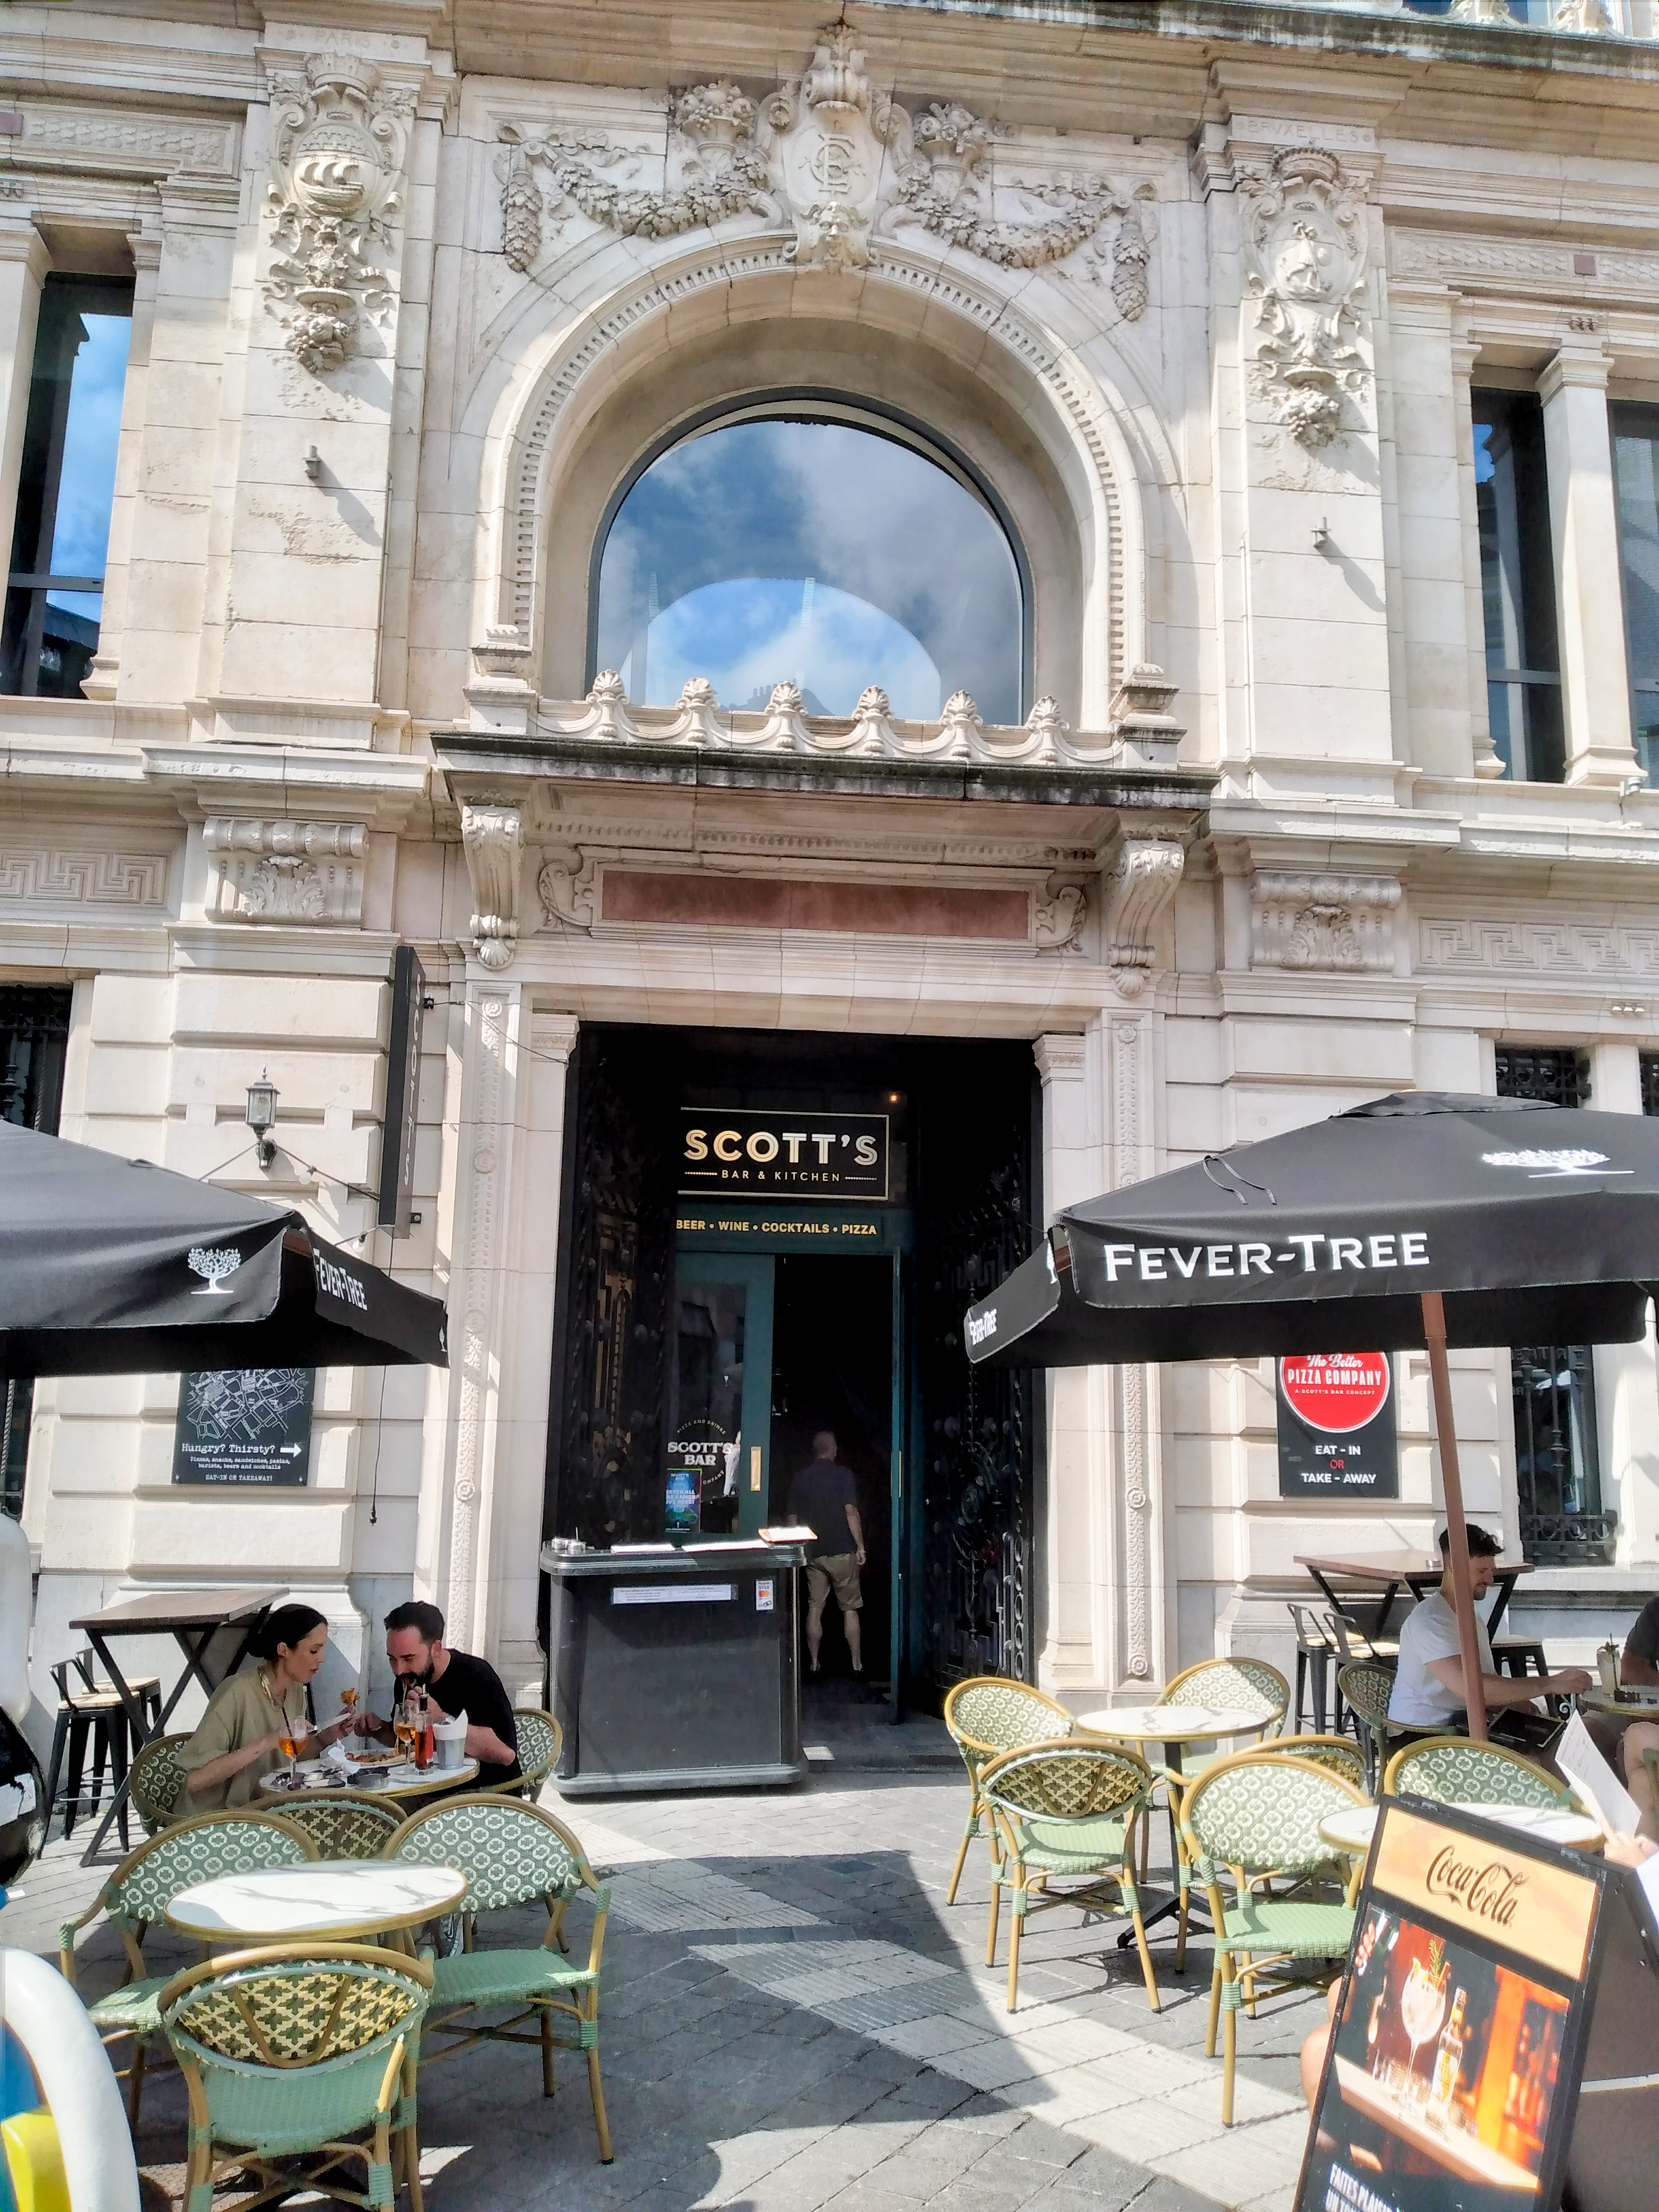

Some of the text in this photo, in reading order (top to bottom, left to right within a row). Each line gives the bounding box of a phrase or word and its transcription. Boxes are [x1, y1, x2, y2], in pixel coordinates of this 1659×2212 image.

[683, 1129, 878, 1166] SCOTT'S
[722, 1170, 840, 1182] BAR & KITCHEN
[676, 1220, 877, 1235] BEER WINE COCKTAILS PIZZA
[1103, 1233, 1430, 1281] FEVER-TREE
[1306, 1353, 1364, 1368] The Better
[1287, 1369, 1382, 1386] PIZZA COMPANY
[676, 1422, 692, 1434] PIZZA
[707, 1420, 726, 1435] DRINKS
[181, 1443, 275, 1455] Hungry? Thirsty?
[667, 1442, 733, 1454] SCOTT'S
[1315, 1445, 1337, 1455] EAT
[1348, 1446, 1361, 1455] IN
[684, 1454, 716, 1466] BAR
[1329, 1460, 1345, 1470] OR
[702, 1470, 725, 1485] OMPANY
[1301, 1473, 1332, 1483] TAKE
[1343, 1473, 1377, 1484] AWAY
[1329, 2163, 1360, 2203] FAITES
[1357, 2185, 1393, 2212] PLAIS
